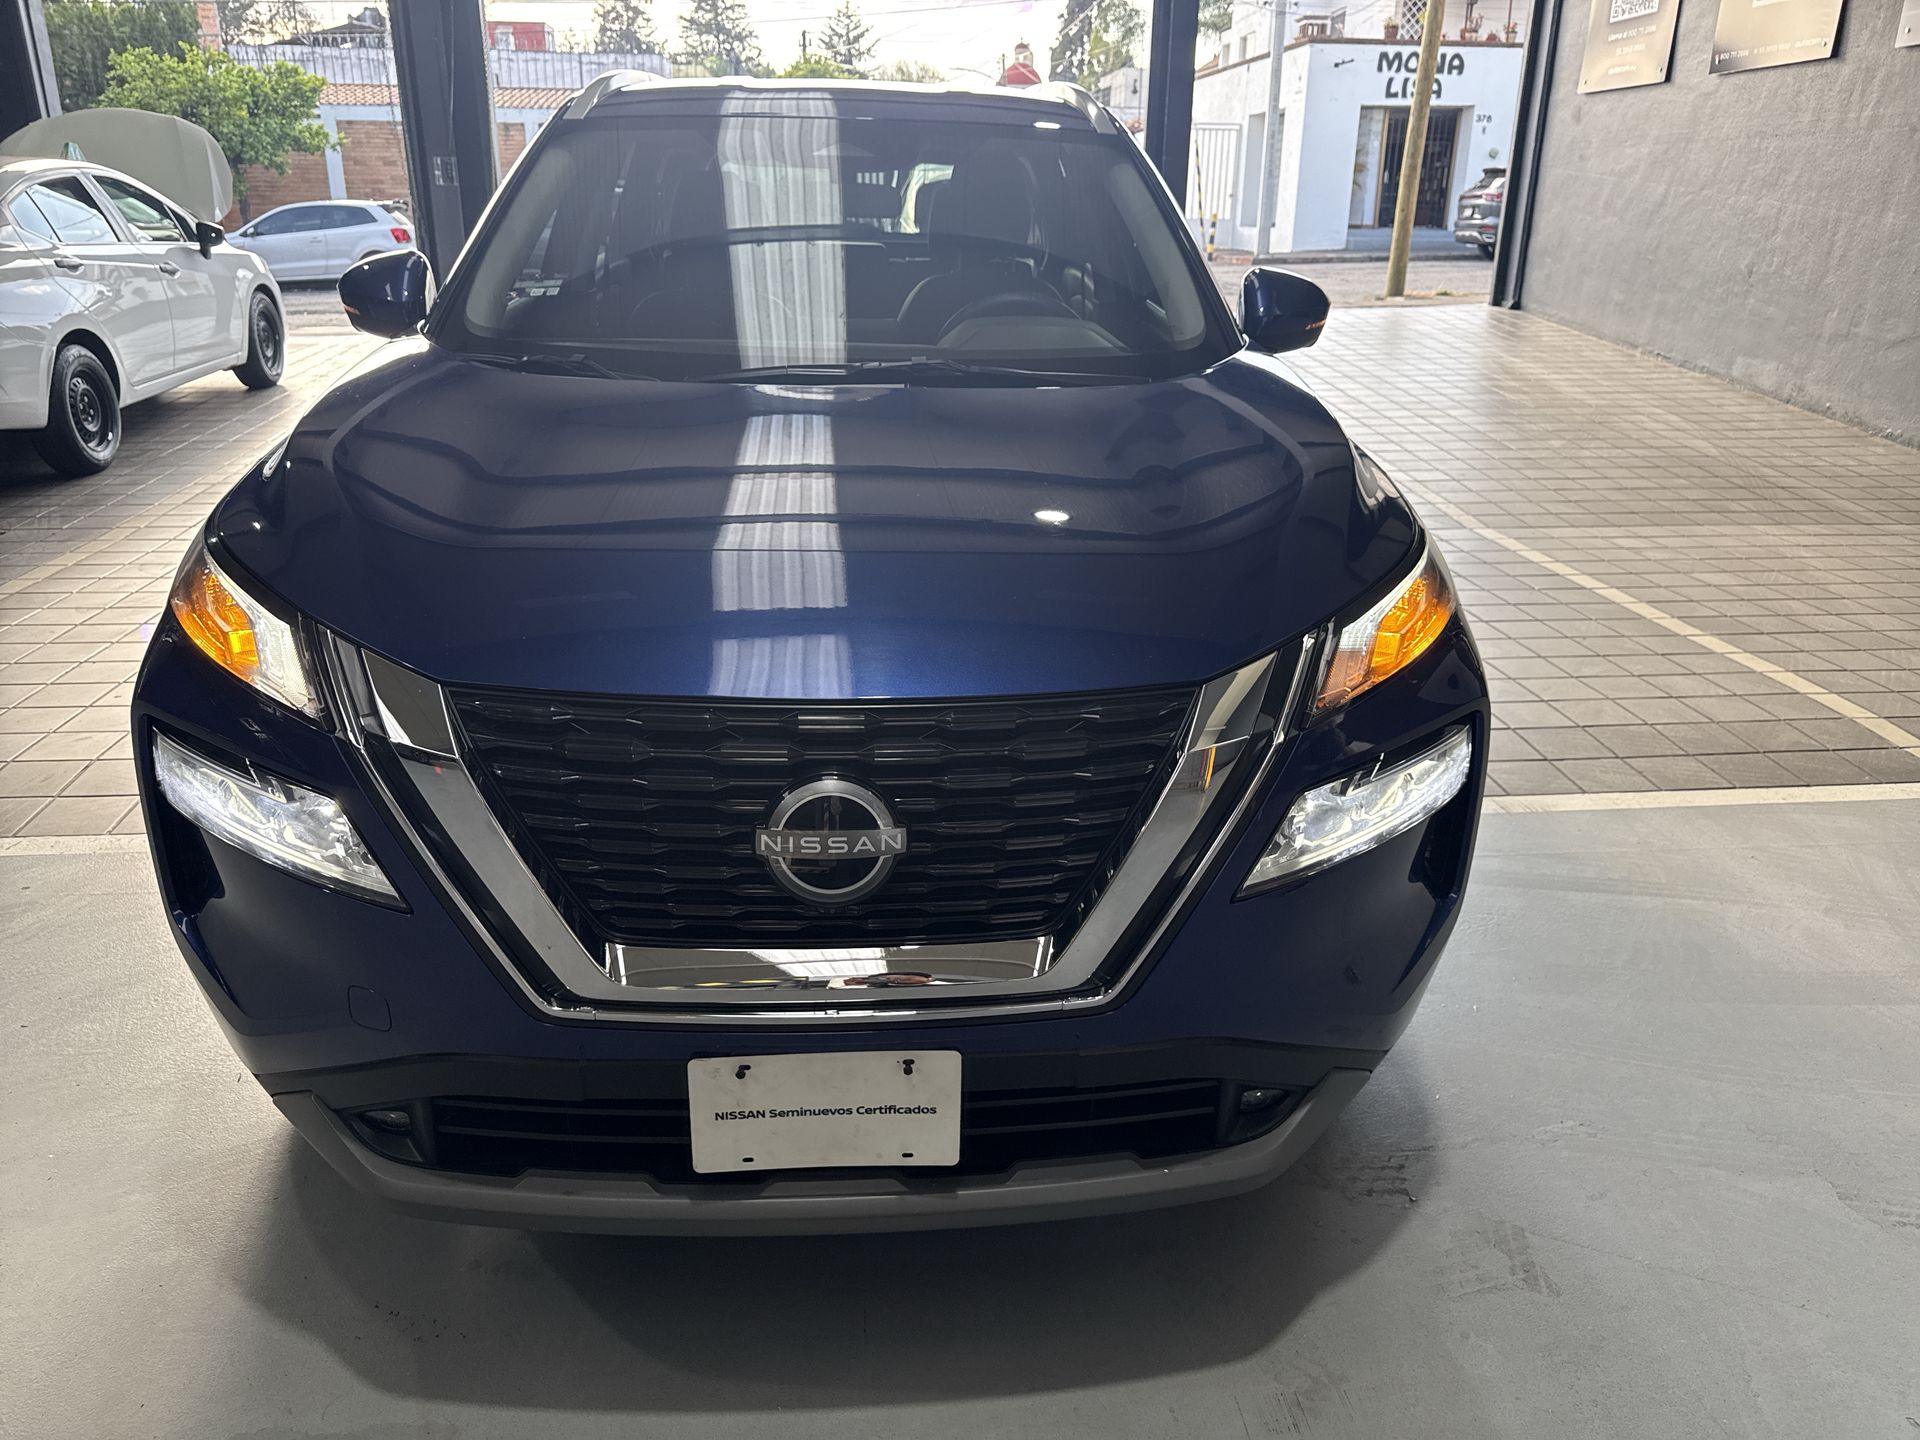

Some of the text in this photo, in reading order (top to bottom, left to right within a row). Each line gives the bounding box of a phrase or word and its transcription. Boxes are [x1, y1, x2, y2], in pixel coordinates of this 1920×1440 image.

[1385, 77, 1442, 99] LIA
[760, 833, 902, 854] NISSAN
[714, 1104, 938, 1121] NISSAN Seminuevos Certificados
